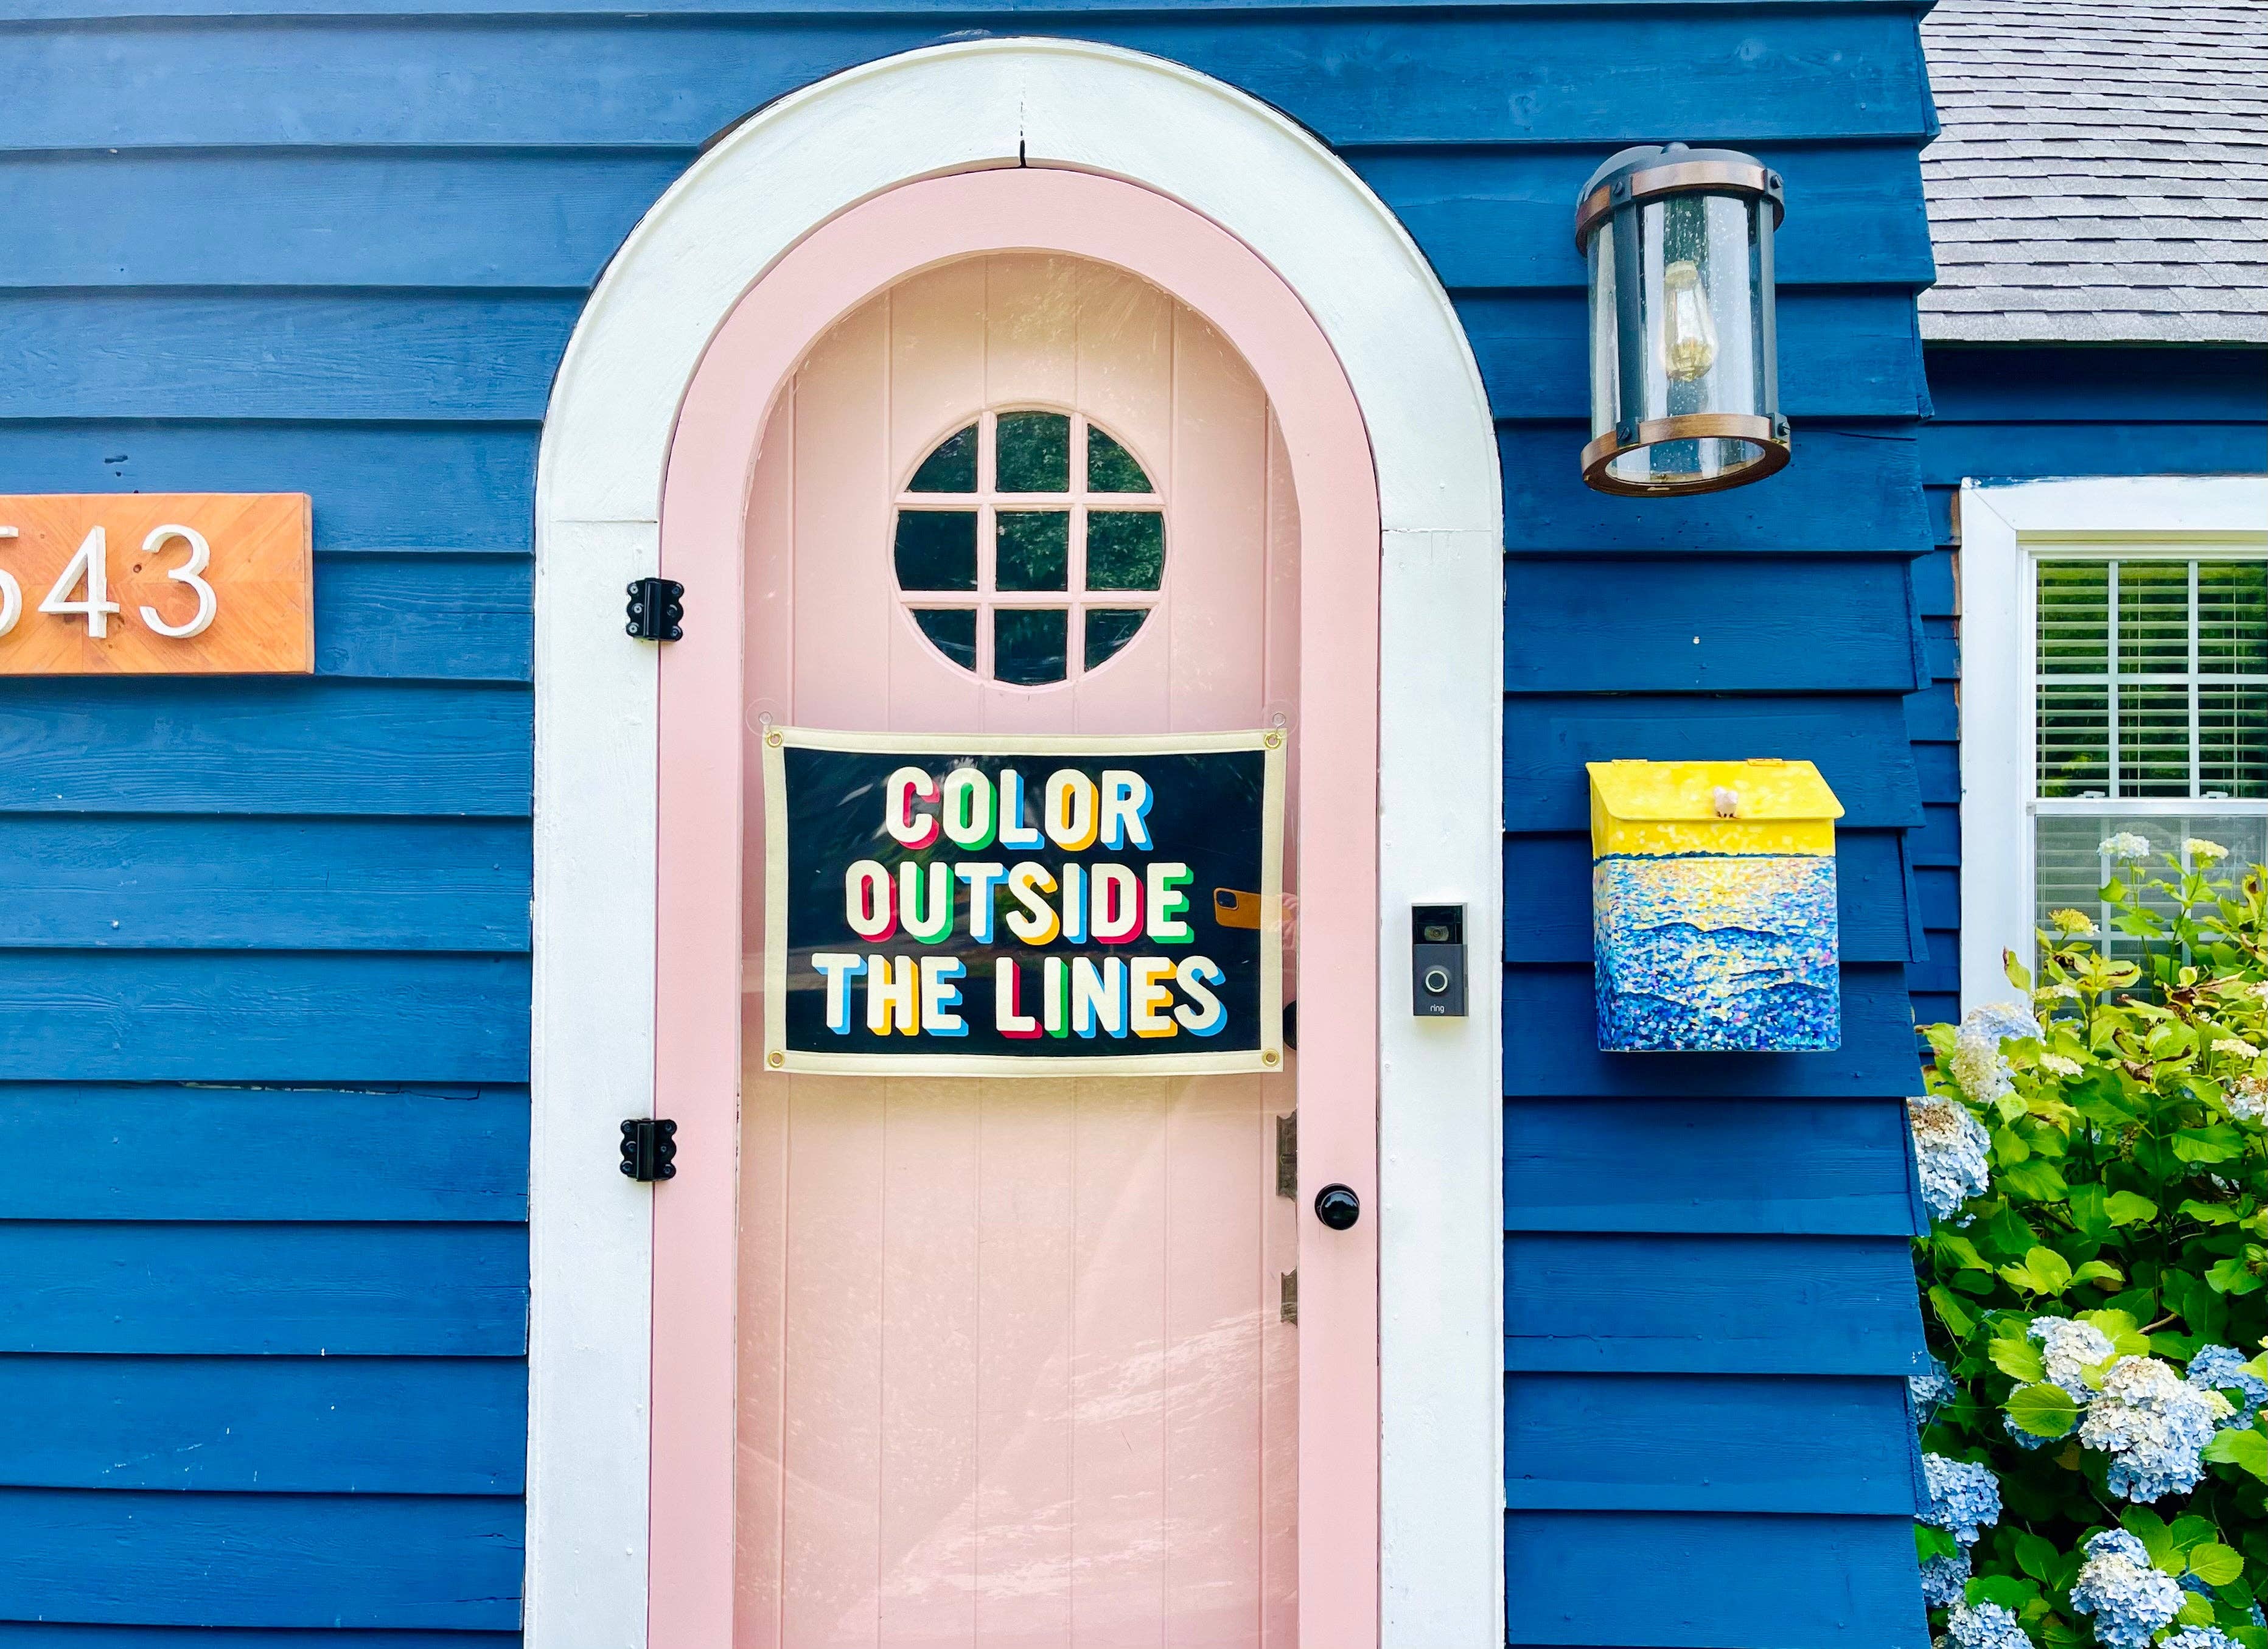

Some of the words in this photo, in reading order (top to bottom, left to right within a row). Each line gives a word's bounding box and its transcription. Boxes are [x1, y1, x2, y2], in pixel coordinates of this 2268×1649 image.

[886, 767, 1153, 850] COLOR
[846, 860, 1194, 945] OUTSIDE
[812, 953, 969, 1036] THE
[996, 955, 1227, 1038] LINES
[1430, 1003, 1445, 1014] ring
